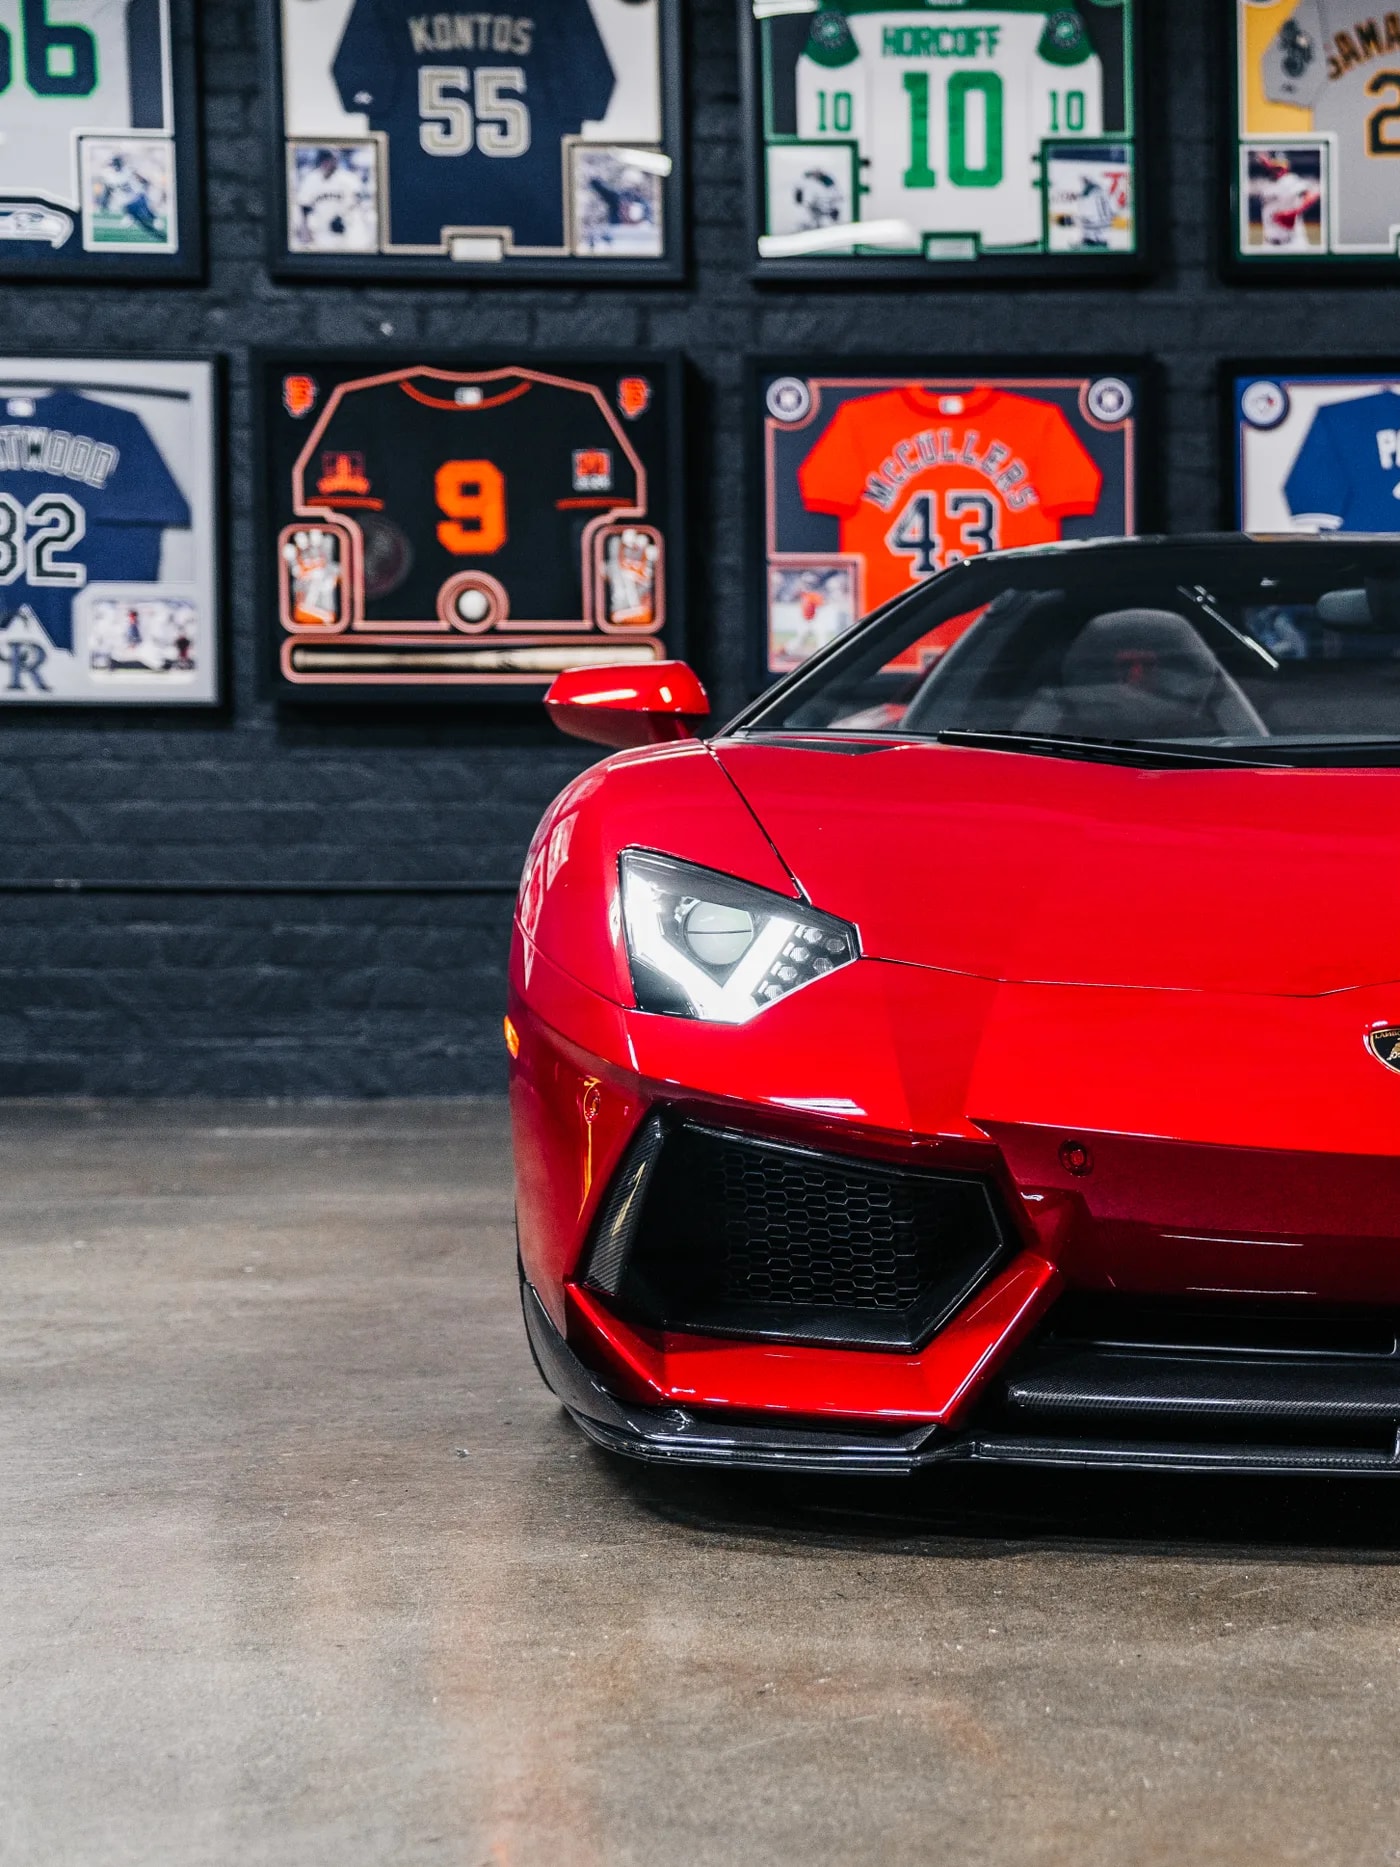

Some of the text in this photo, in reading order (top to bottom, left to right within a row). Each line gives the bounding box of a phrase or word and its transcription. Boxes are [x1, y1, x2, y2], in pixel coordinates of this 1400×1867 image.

[0, 0, 100, 98] 6
[408, 13, 534, 55] KONTOS
[882, 25, 1001, 57] HORCOFF
[418, 65, 531, 158] 55
[817, 90, 852, 131] 10
[903, 71, 1003, 188] 10
[1049, 90, 1085, 131] 10
[434, 459, 508, 556] 9
[884, 489, 1002, 579] 43
